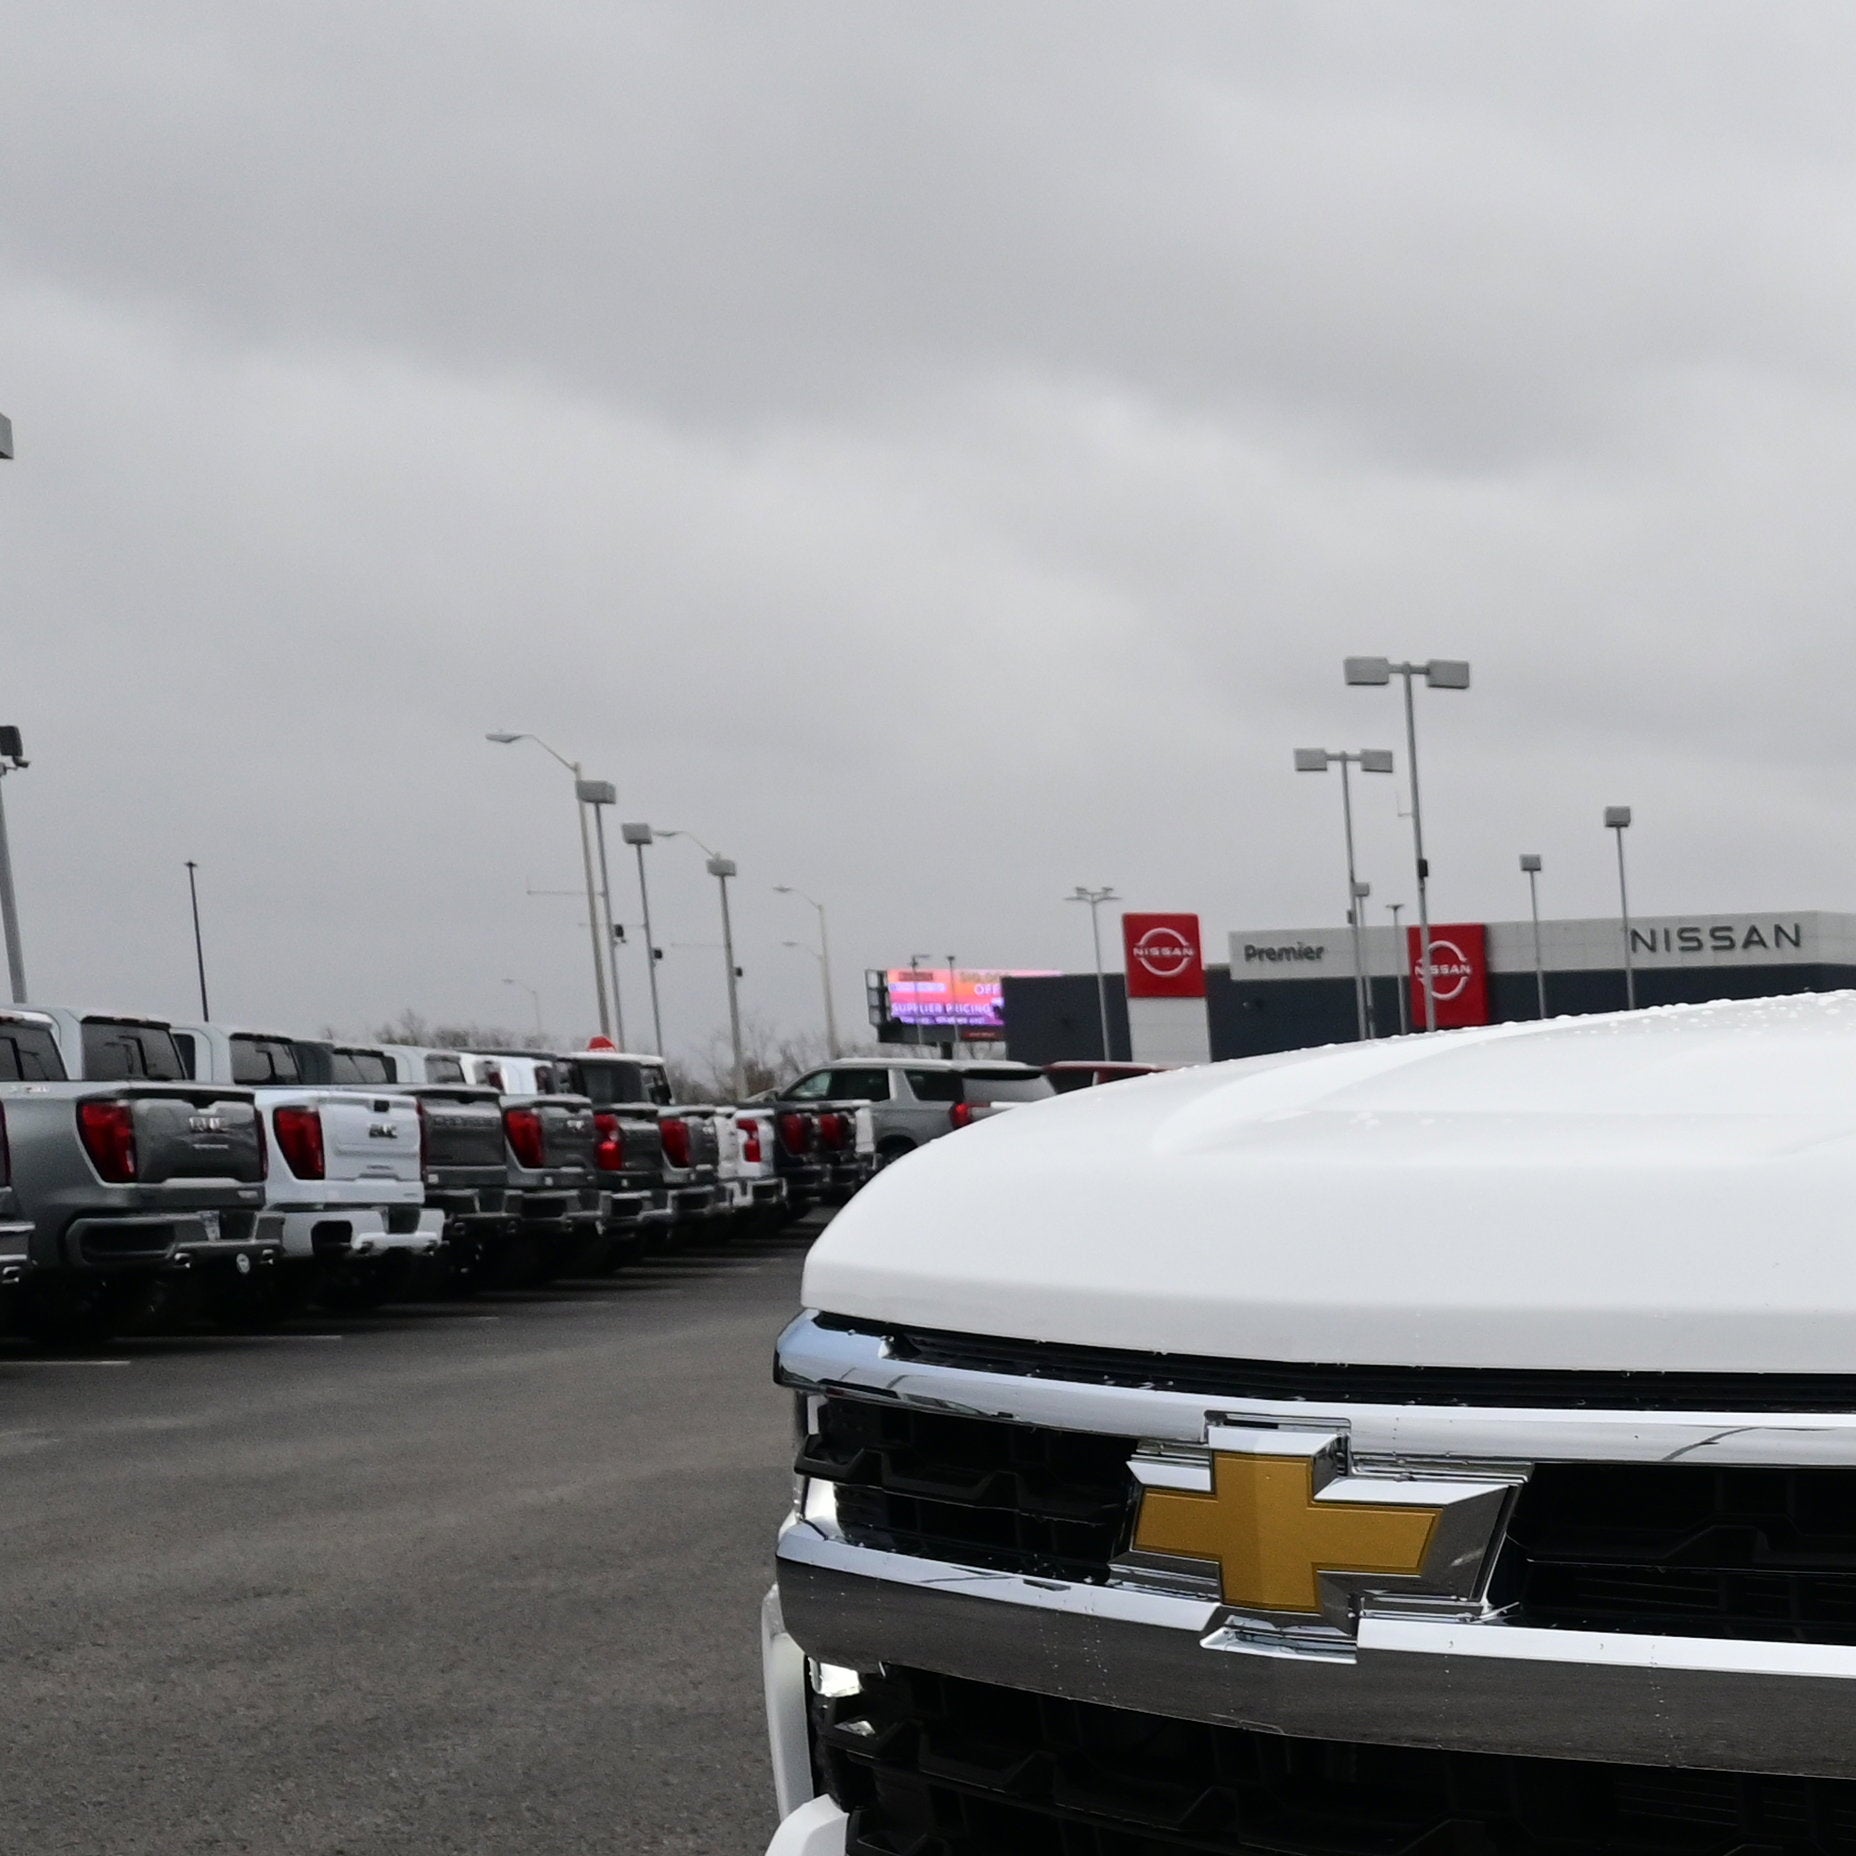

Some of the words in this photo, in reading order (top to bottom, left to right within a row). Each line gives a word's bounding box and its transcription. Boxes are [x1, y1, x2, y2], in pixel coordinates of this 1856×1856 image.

[1629, 922, 1802, 954] NISSAN
[1132, 946, 1195, 957] NISSAN
[1243, 942, 1325, 962] Premier
[1414, 964, 1472, 976] NSSAN
